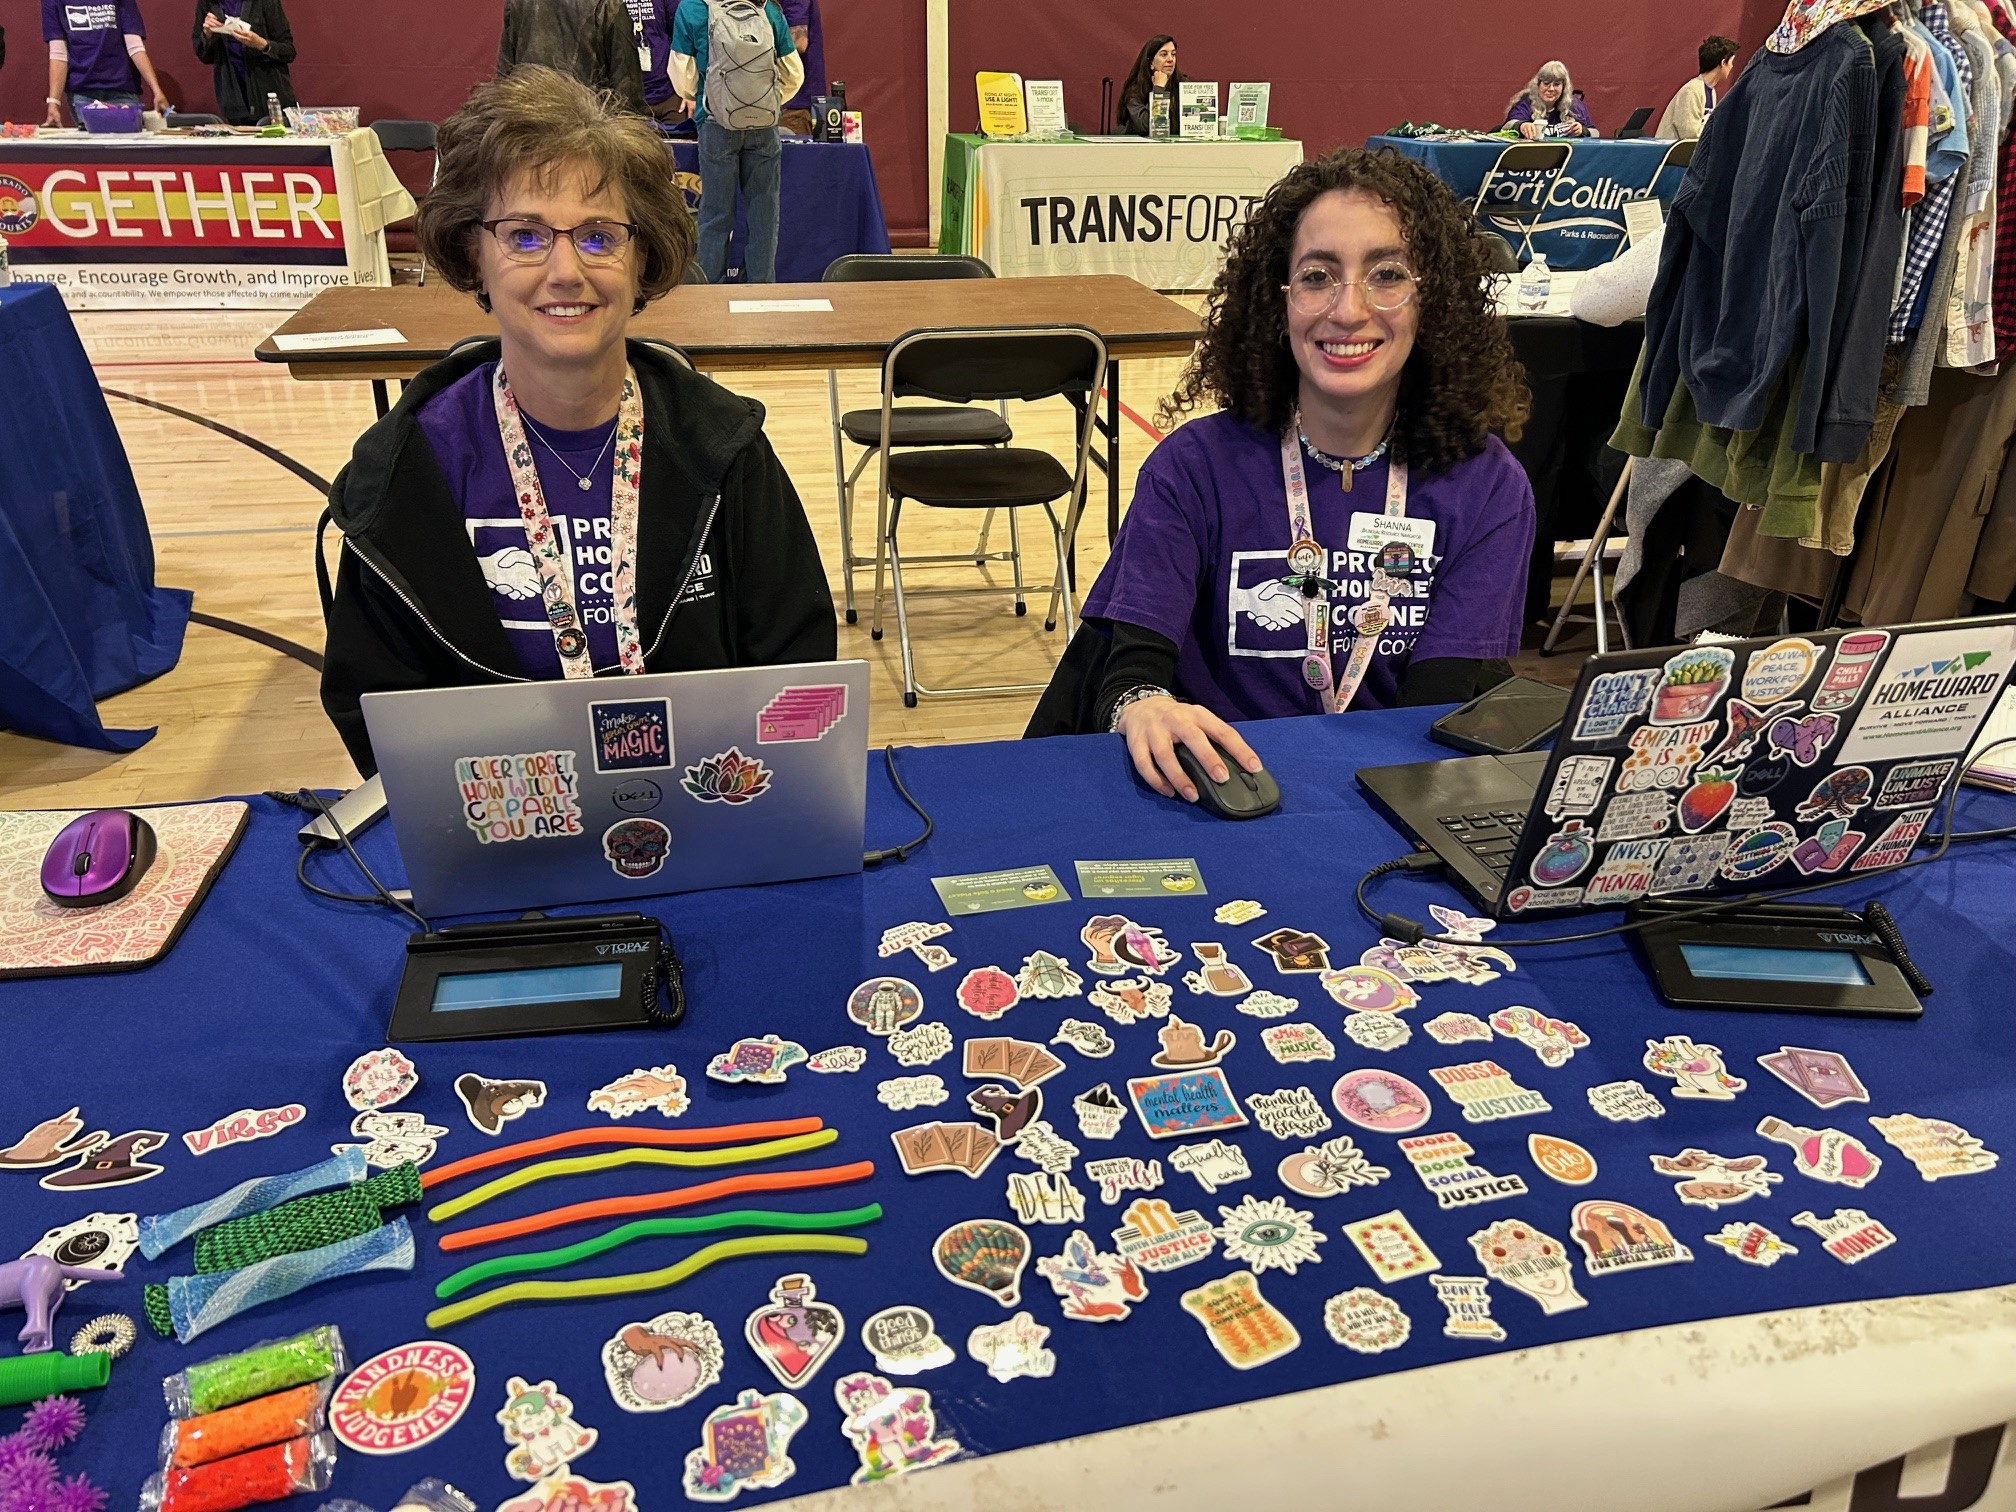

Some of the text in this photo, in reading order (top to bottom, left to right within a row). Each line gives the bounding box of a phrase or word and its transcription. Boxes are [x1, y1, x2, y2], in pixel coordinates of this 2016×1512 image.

[1479, 172, 1545, 205] Fort
[1560, 229, 1580, 238] Parks
[1587, 230, 1620, 240] Recreation
[9, 269, 376, 288] hange, Encourage Growth, and Improve Lives!
[71, 290, 87, 298] and
[89, 289, 146, 299] accountability.
[148, 290, 162, 298] We
[163, 291, 201, 300] empower
[202, 290, 225, 298] those
[226, 289, 257, 299] affected
[258, 290, 269, 300] by
[270, 290, 291, 298] crime
[292, 290, 313, 299] while
[1374, 518, 1412, 531] SHANNA
[1298, 553, 1312, 562] safe
[1762, 651, 1787, 661] YOU
[1788, 649, 1821, 659] WANT
[1831, 673, 1859, 684] PILLS
[1835, 665, 1864, 675] CHILL
[1593, 673, 1653, 693] DON'T
[1746, 674, 1805, 686] WORK FOR
[1871, 673, 2000, 705] HOMEWARD
[1745, 687, 1791, 698] JUSTICE
[1879, 703, 1969, 720] ALLIANCE
[602, 712, 637, 730] Make
[1914, 717, 1947, 725] FORWARD
[1631, 722, 1715, 747] EMPATHY
[460, 752, 574, 782] NEVER FORGET
[1890, 763, 1952, 780] UNMAKE
[463, 774, 573, 801] HOW WILDLY
[1886, 775, 1946, 793] UNJUST
[1878, 788, 1937, 806] SYSTEMS
[467, 794, 575, 821] CAPABLE
[477, 814, 579, 841] YOU ARE
[1607, 840, 1670, 861] INVEST
[1880, 838, 1915, 851] HUMAN
[1855, 848, 1908, 868] RIGHTS
[1588, 873, 1651, 893] MENTAL
[882, 924, 949, 955] JUSTICE
[885, 924, 927, 942] CHOOSE
[610, 941, 650, 951] TOPAZ
[1258, 1006, 1282, 1015] JOY
[814, 1048, 850, 1064] power
[1145, 1082, 1219, 1108] mental health
[1448, 1079, 1517, 1101] SOCIAL
[1253, 1089, 1311, 1110] thankful
[1467, 1094, 1545, 1119] JUSTICE
[1155, 1102, 1219, 1119] matters
[1260, 1102, 1318, 1122] grateful
[1273, 1115, 1328, 1137] blessed
[1402, 1134, 1457, 1150] BOOKS
[1173, 1141, 1244, 1168] actually
[1411, 1144, 1468, 1161] COFFEE
[1091, 1164, 1131, 1177] WORLD?
[1420, 1158, 1464, 1174] DOGS
[1429, 1170, 1487, 1187] SOCIAL
[1440, 1178, 1523, 1205] JUSTICE
[1123, 1242, 1149, 1254] WITH
[1189, 1223, 1209, 1233] AND
[1138, 1233, 1211, 1262] JUSTICE
[1828, 1223, 1891, 1260] MONEY
[1161, 1250, 1199, 1266] FOR ALL
[1500, 1254, 1565, 1279] END THE STIGMA
[1591, 1261, 1611, 1270] FOR
[1612, 1254, 1648, 1266] SOCIAL
[1207, 1290, 1239, 1307] EQUITY
[1442, 1285, 1481, 1296] DON'T
[1449, 1303, 1484, 1314] YOUR
[875, 1312, 916, 1336] good
[879, 1327, 922, 1350] things
[342, 1349, 462, 1402] KINDNESS
[340, 1385, 464, 1447] JUDGEMENT
